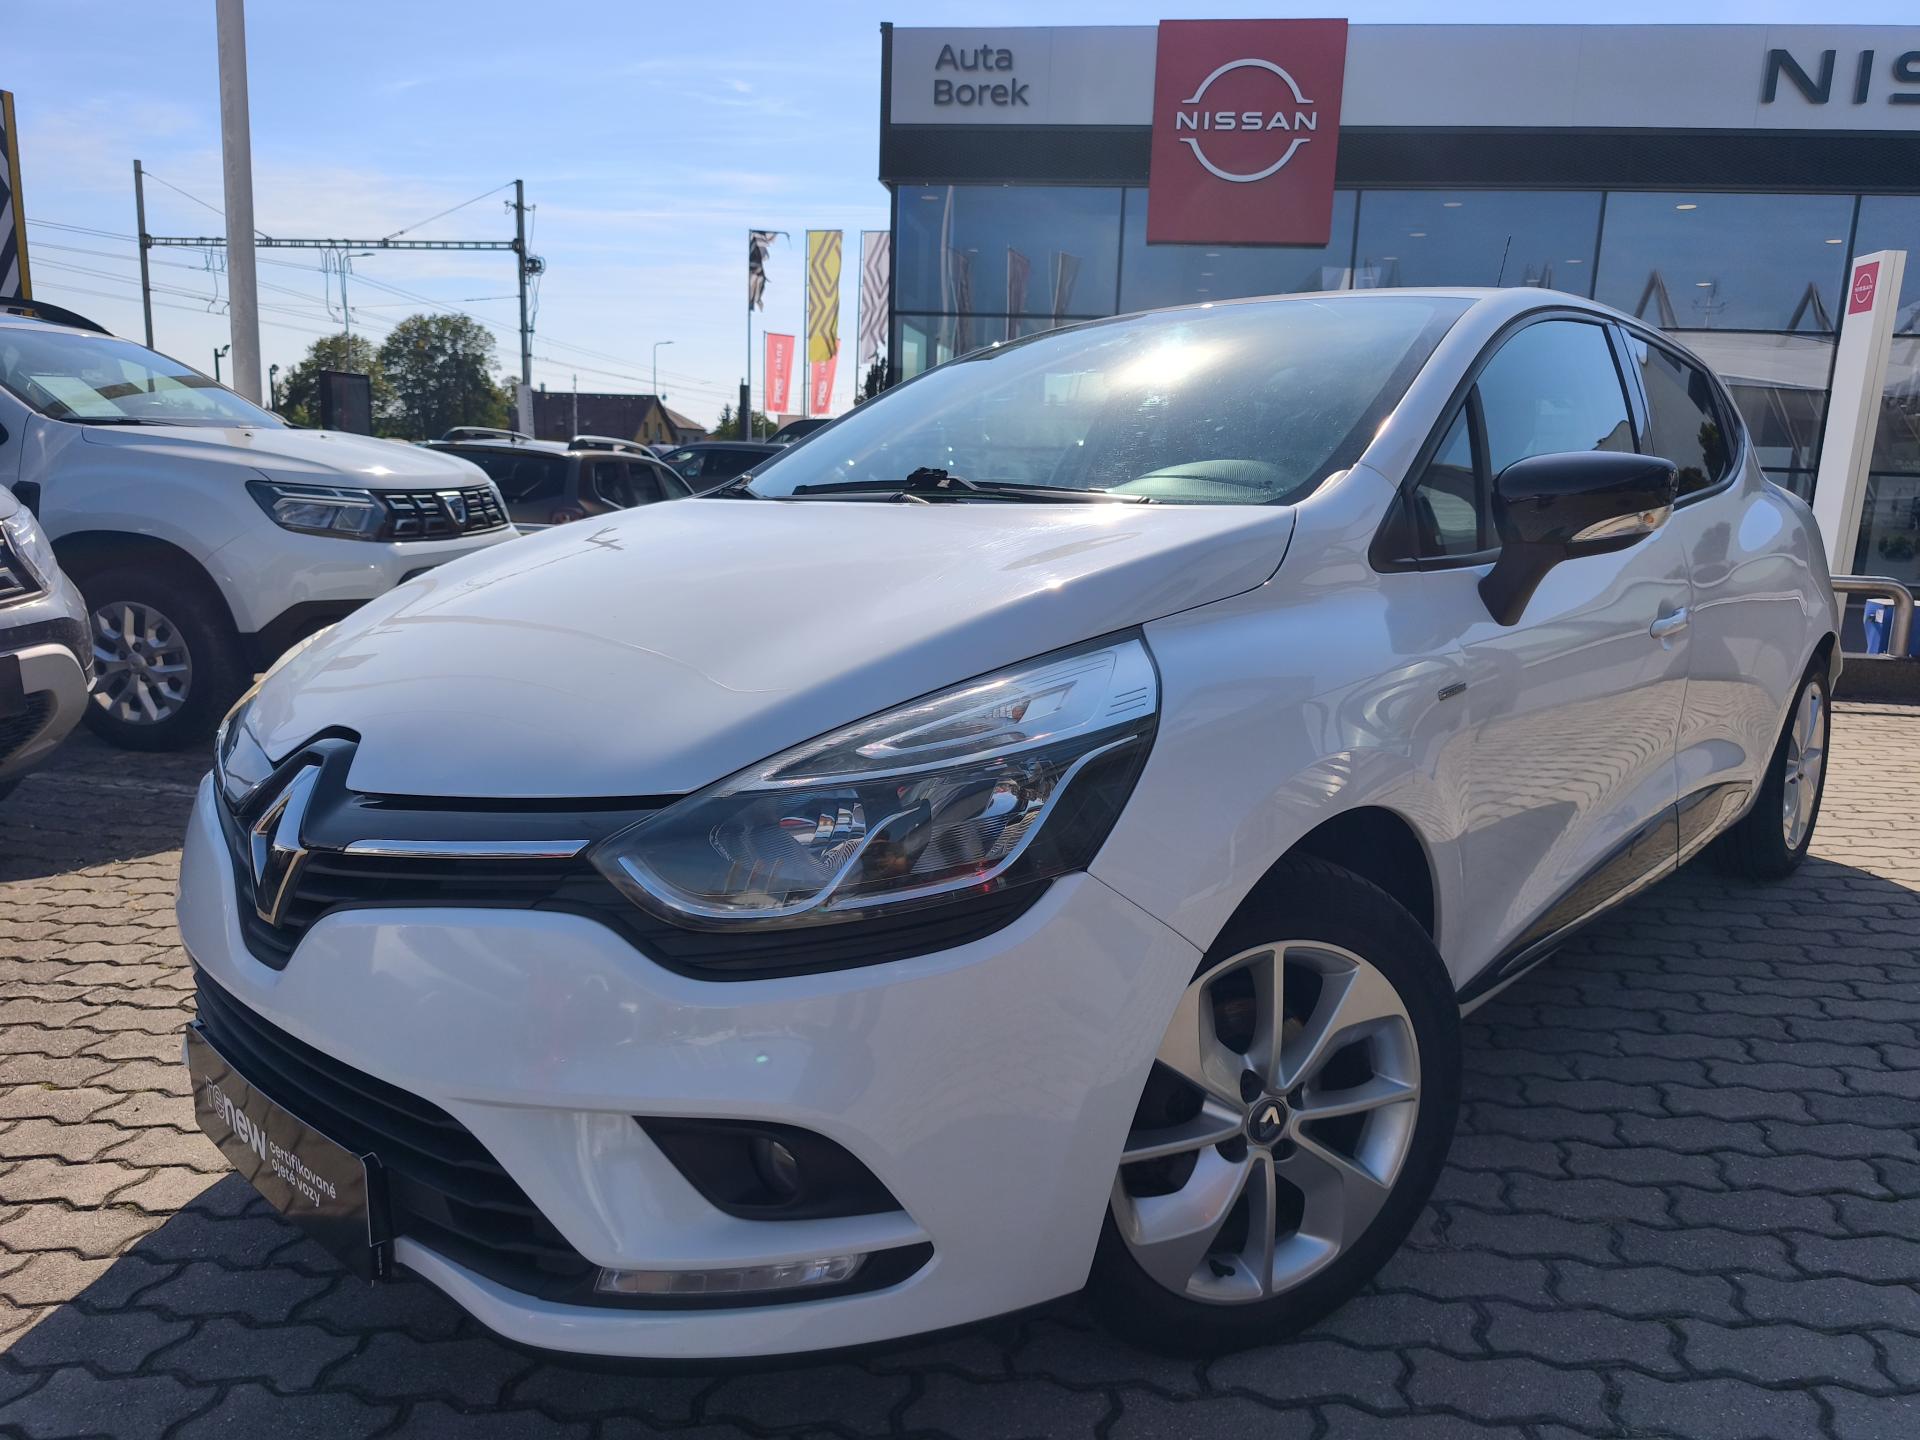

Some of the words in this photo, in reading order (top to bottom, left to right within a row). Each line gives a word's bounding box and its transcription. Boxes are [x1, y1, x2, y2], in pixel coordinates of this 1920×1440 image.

[934, 43, 1013, 72] Auta
[933, 77, 1030, 107] Borek
[1175, 110, 1318, 131] NISSAN
[1854, 284, 1873, 292] NISSAN
[205, 1075, 266, 1161] renew
[269, 1140, 337, 1199] certifikované
[296, 1179, 321, 1208] vozy
